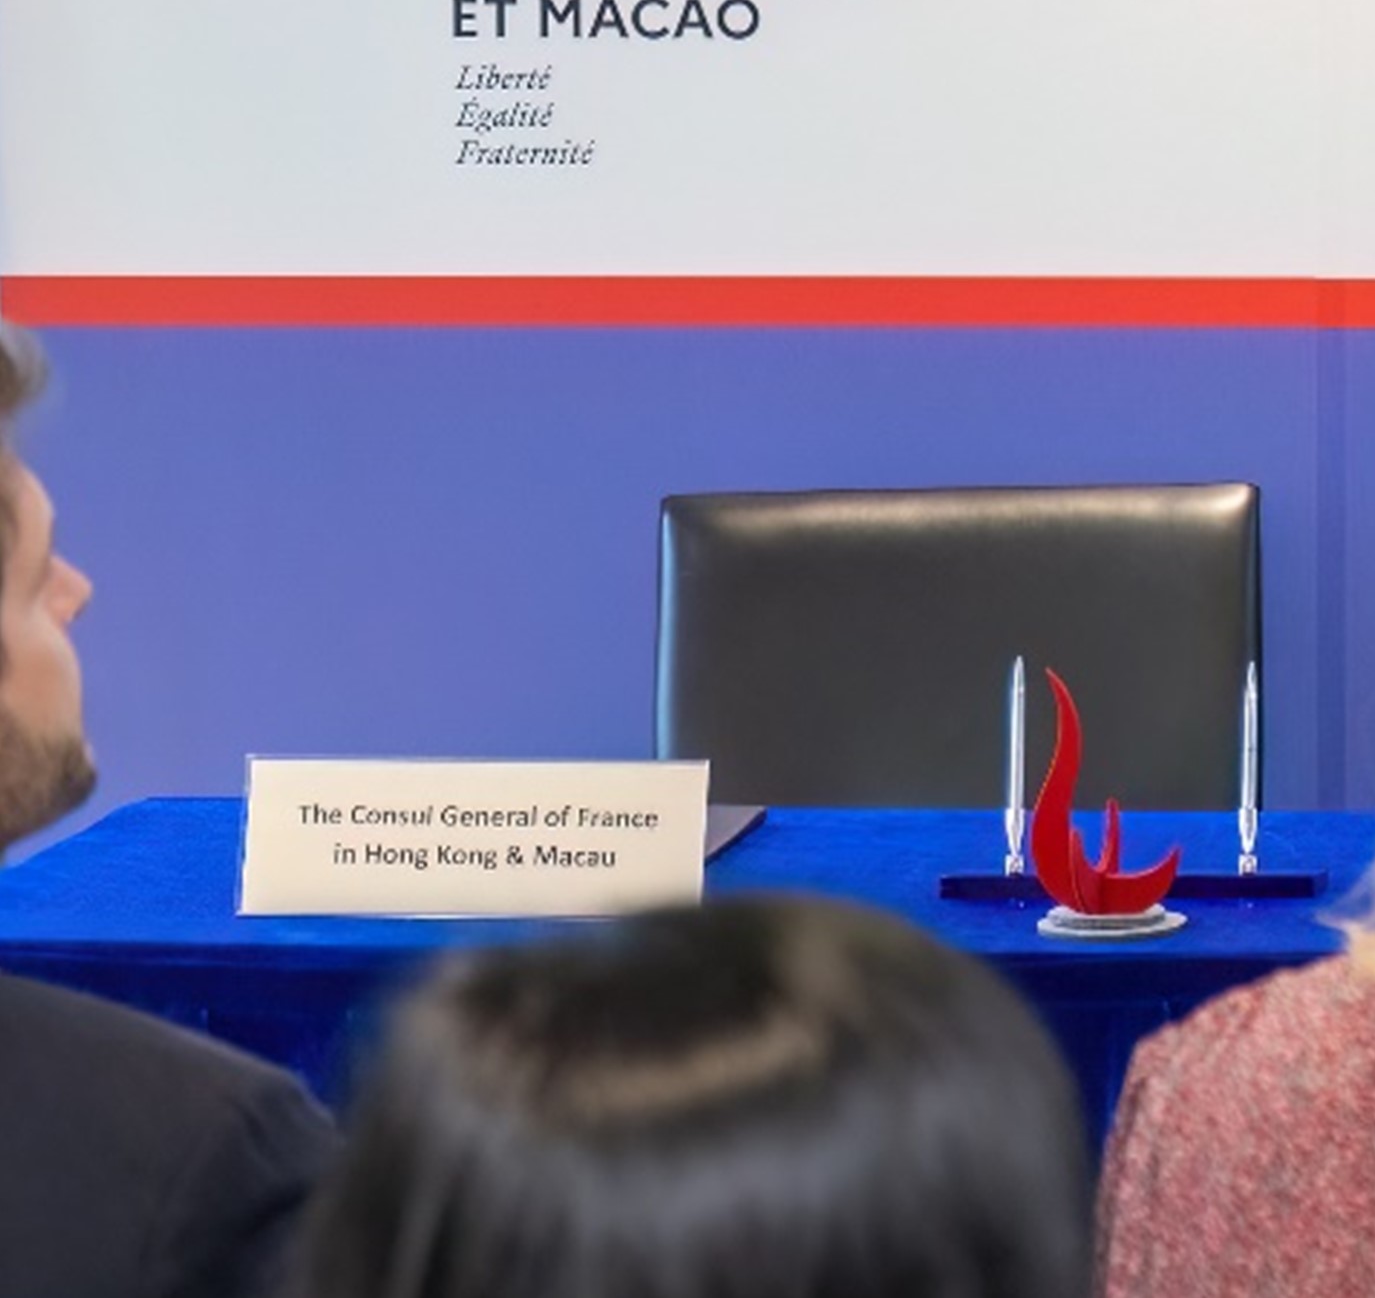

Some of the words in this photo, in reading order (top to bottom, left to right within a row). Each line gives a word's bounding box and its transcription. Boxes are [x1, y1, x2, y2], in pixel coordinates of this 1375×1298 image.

[456, 64, 551, 89] Liberté
[456, 97, 554, 132] Égalité
[456, 140, 594, 164] Fraternité
[300, 804, 342, 824] The
[351, 805, 433, 825] Consul
[440, 805, 537, 827] General
[544, 805, 571, 827] of
[579, 808, 658, 827] France
[334, 843, 355, 863] in
[366, 844, 428, 870] Hong
[438, 846, 497, 869] Kong
[506, 846, 523, 864] &
[534, 846, 615, 867] Macau
